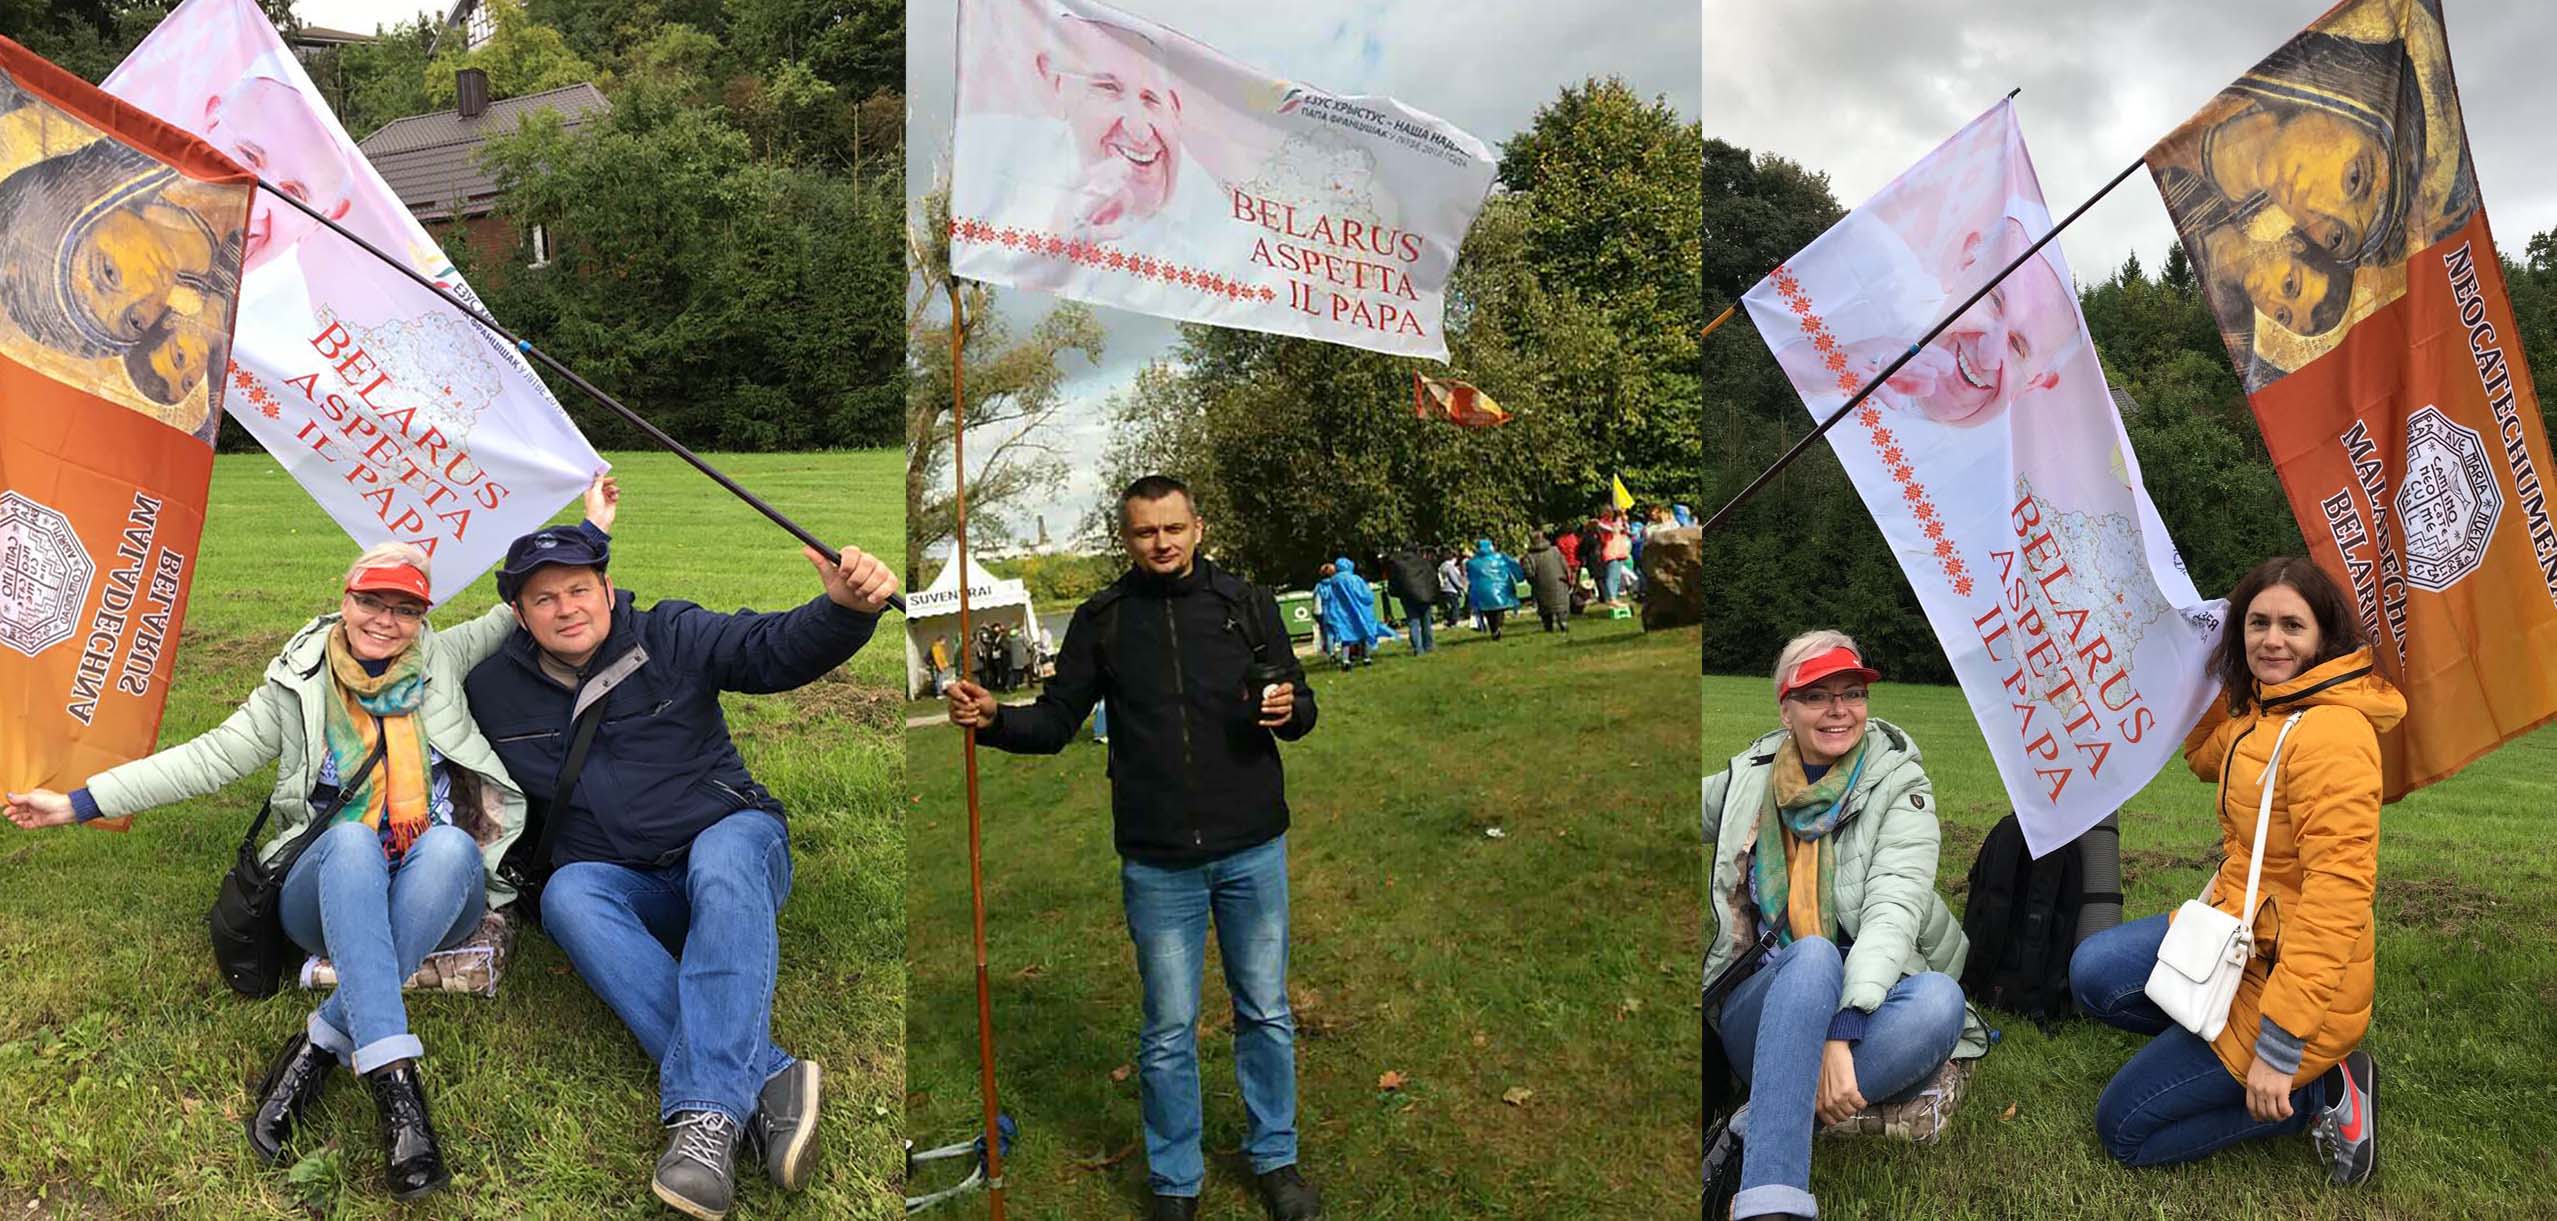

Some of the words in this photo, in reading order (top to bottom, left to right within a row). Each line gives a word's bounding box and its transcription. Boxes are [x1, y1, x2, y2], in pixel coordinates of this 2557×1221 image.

[1301, 106, 1328, 120] ПАПА
[1332, 101, 1386, 123] ХРЫСТУС
[1394, 120, 1429, 139] НАША
[1232, 188, 1424, 263] BELARUS
[453, 282, 480, 312] ЕЗУС
[1250, 237, 1421, 301] ASPETTA
[1288, 278, 1321, 316] IL
[1330, 292, 1426, 338] PAPA
[308, 321, 510, 511] BELARUS
[2443, 240, 2557, 608] NEOCATECHUMEN
[282, 373, 472, 543] ASPETTA
[296, 418, 337, 463] IL
[343, 463, 439, 560] PAPA
[2445, 431, 2466, 451] AVE
[2465, 452, 2488, 495] MARIA
[910, 585, 992, 606] SUVENRAI
[2011, 493, 2155, 744] BELARUS
[1989, 550, 2112, 780] ASPETTA
[1972, 601, 2010, 663] IL
[2002, 665, 2073, 806] PAPA
